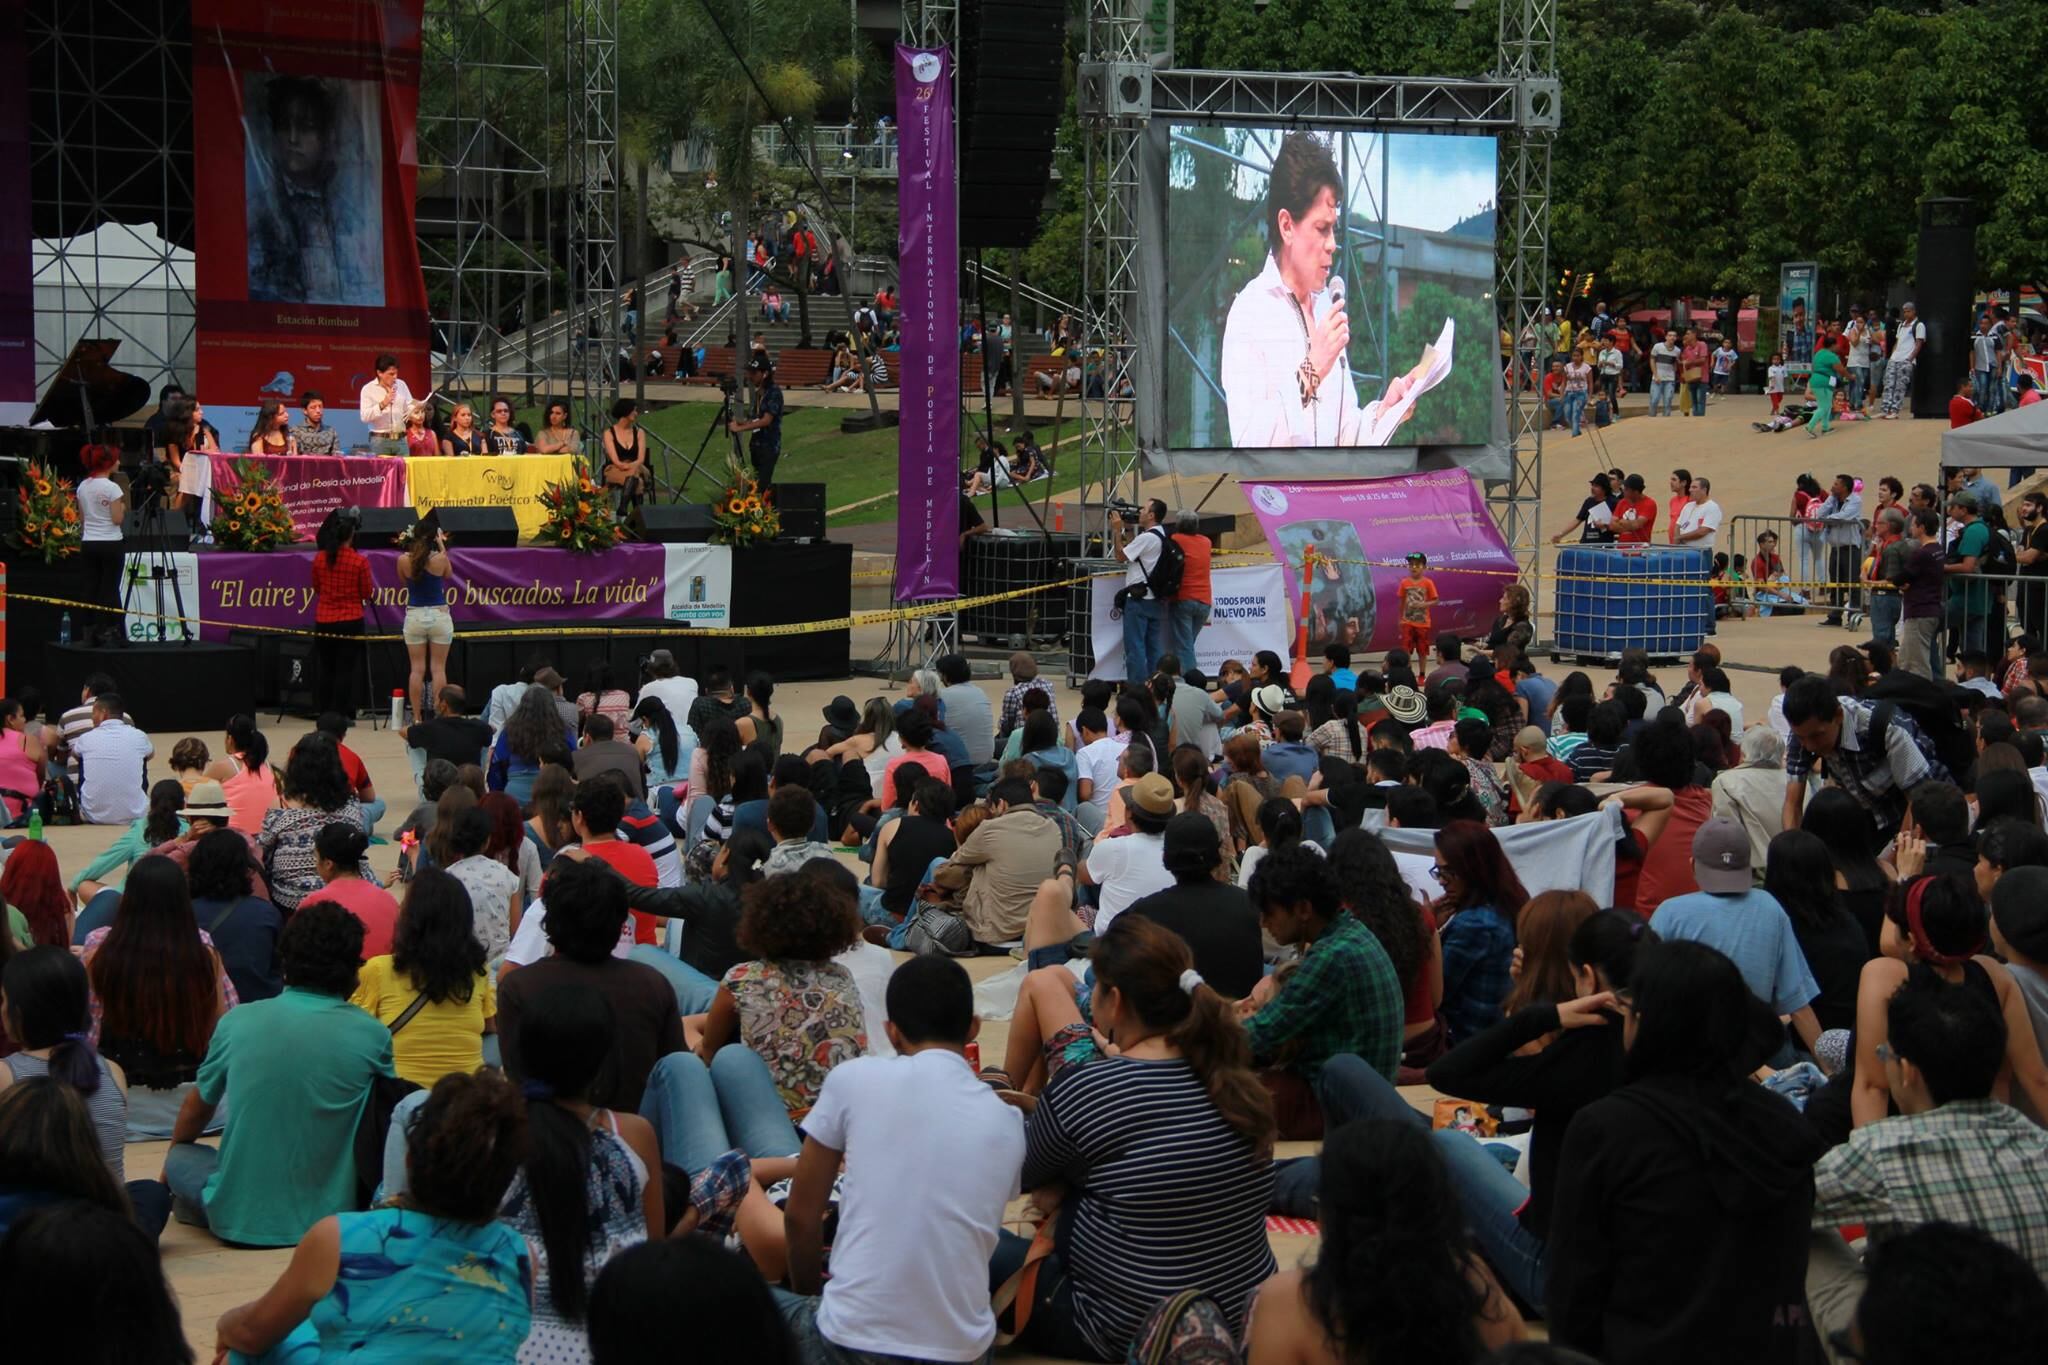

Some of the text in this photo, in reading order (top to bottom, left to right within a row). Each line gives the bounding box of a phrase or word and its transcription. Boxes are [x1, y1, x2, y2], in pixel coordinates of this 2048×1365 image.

[923, 105, 932, 190] FESTIVAL
[926, 203, 934, 342] INTERNACIONAL
[277, 314, 359, 328] Estación Rimbaud
[927, 355, 934, 375] DE
[299, 480, 311, 489] de
[312, 478, 338, 489] Poesía
[340, 478, 351, 487] de
[352, 474, 386, 485] Medellín
[927, 467, 933, 486] DE
[488, 493, 530, 505] Poético
[250, 580, 294, 607] aire
[298, 587, 315, 614] y
[464, 579, 566, 606] buscados.
[573, 579, 598, 605] La
[1215, 596, 1266, 606] TODOS POR UN
[1214, 605, 1266, 618] NUEVO PAÍS
[1221, 648, 1229, 657] de
